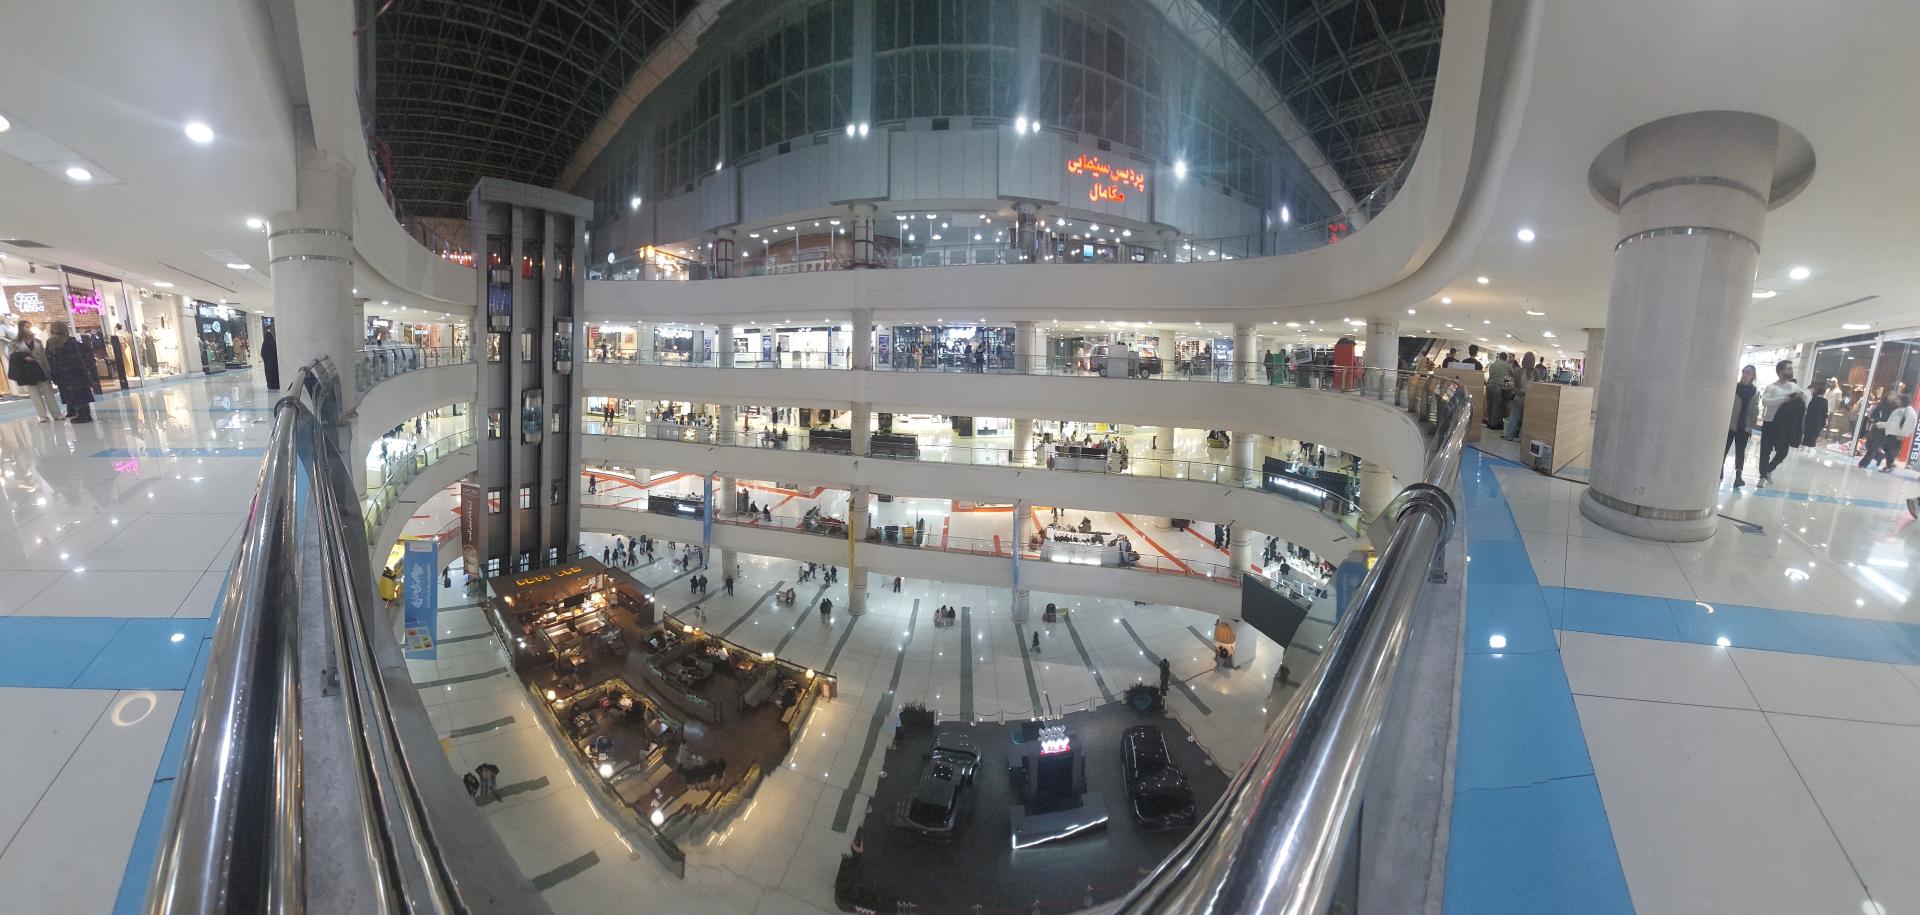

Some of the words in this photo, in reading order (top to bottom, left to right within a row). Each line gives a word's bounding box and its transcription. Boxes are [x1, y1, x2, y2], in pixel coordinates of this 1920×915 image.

[1067, 155, 1110, 177] سینمایی
[1110, 169, 1144, 192] پردیس
[1089, 183, 1124, 202] مگامال
